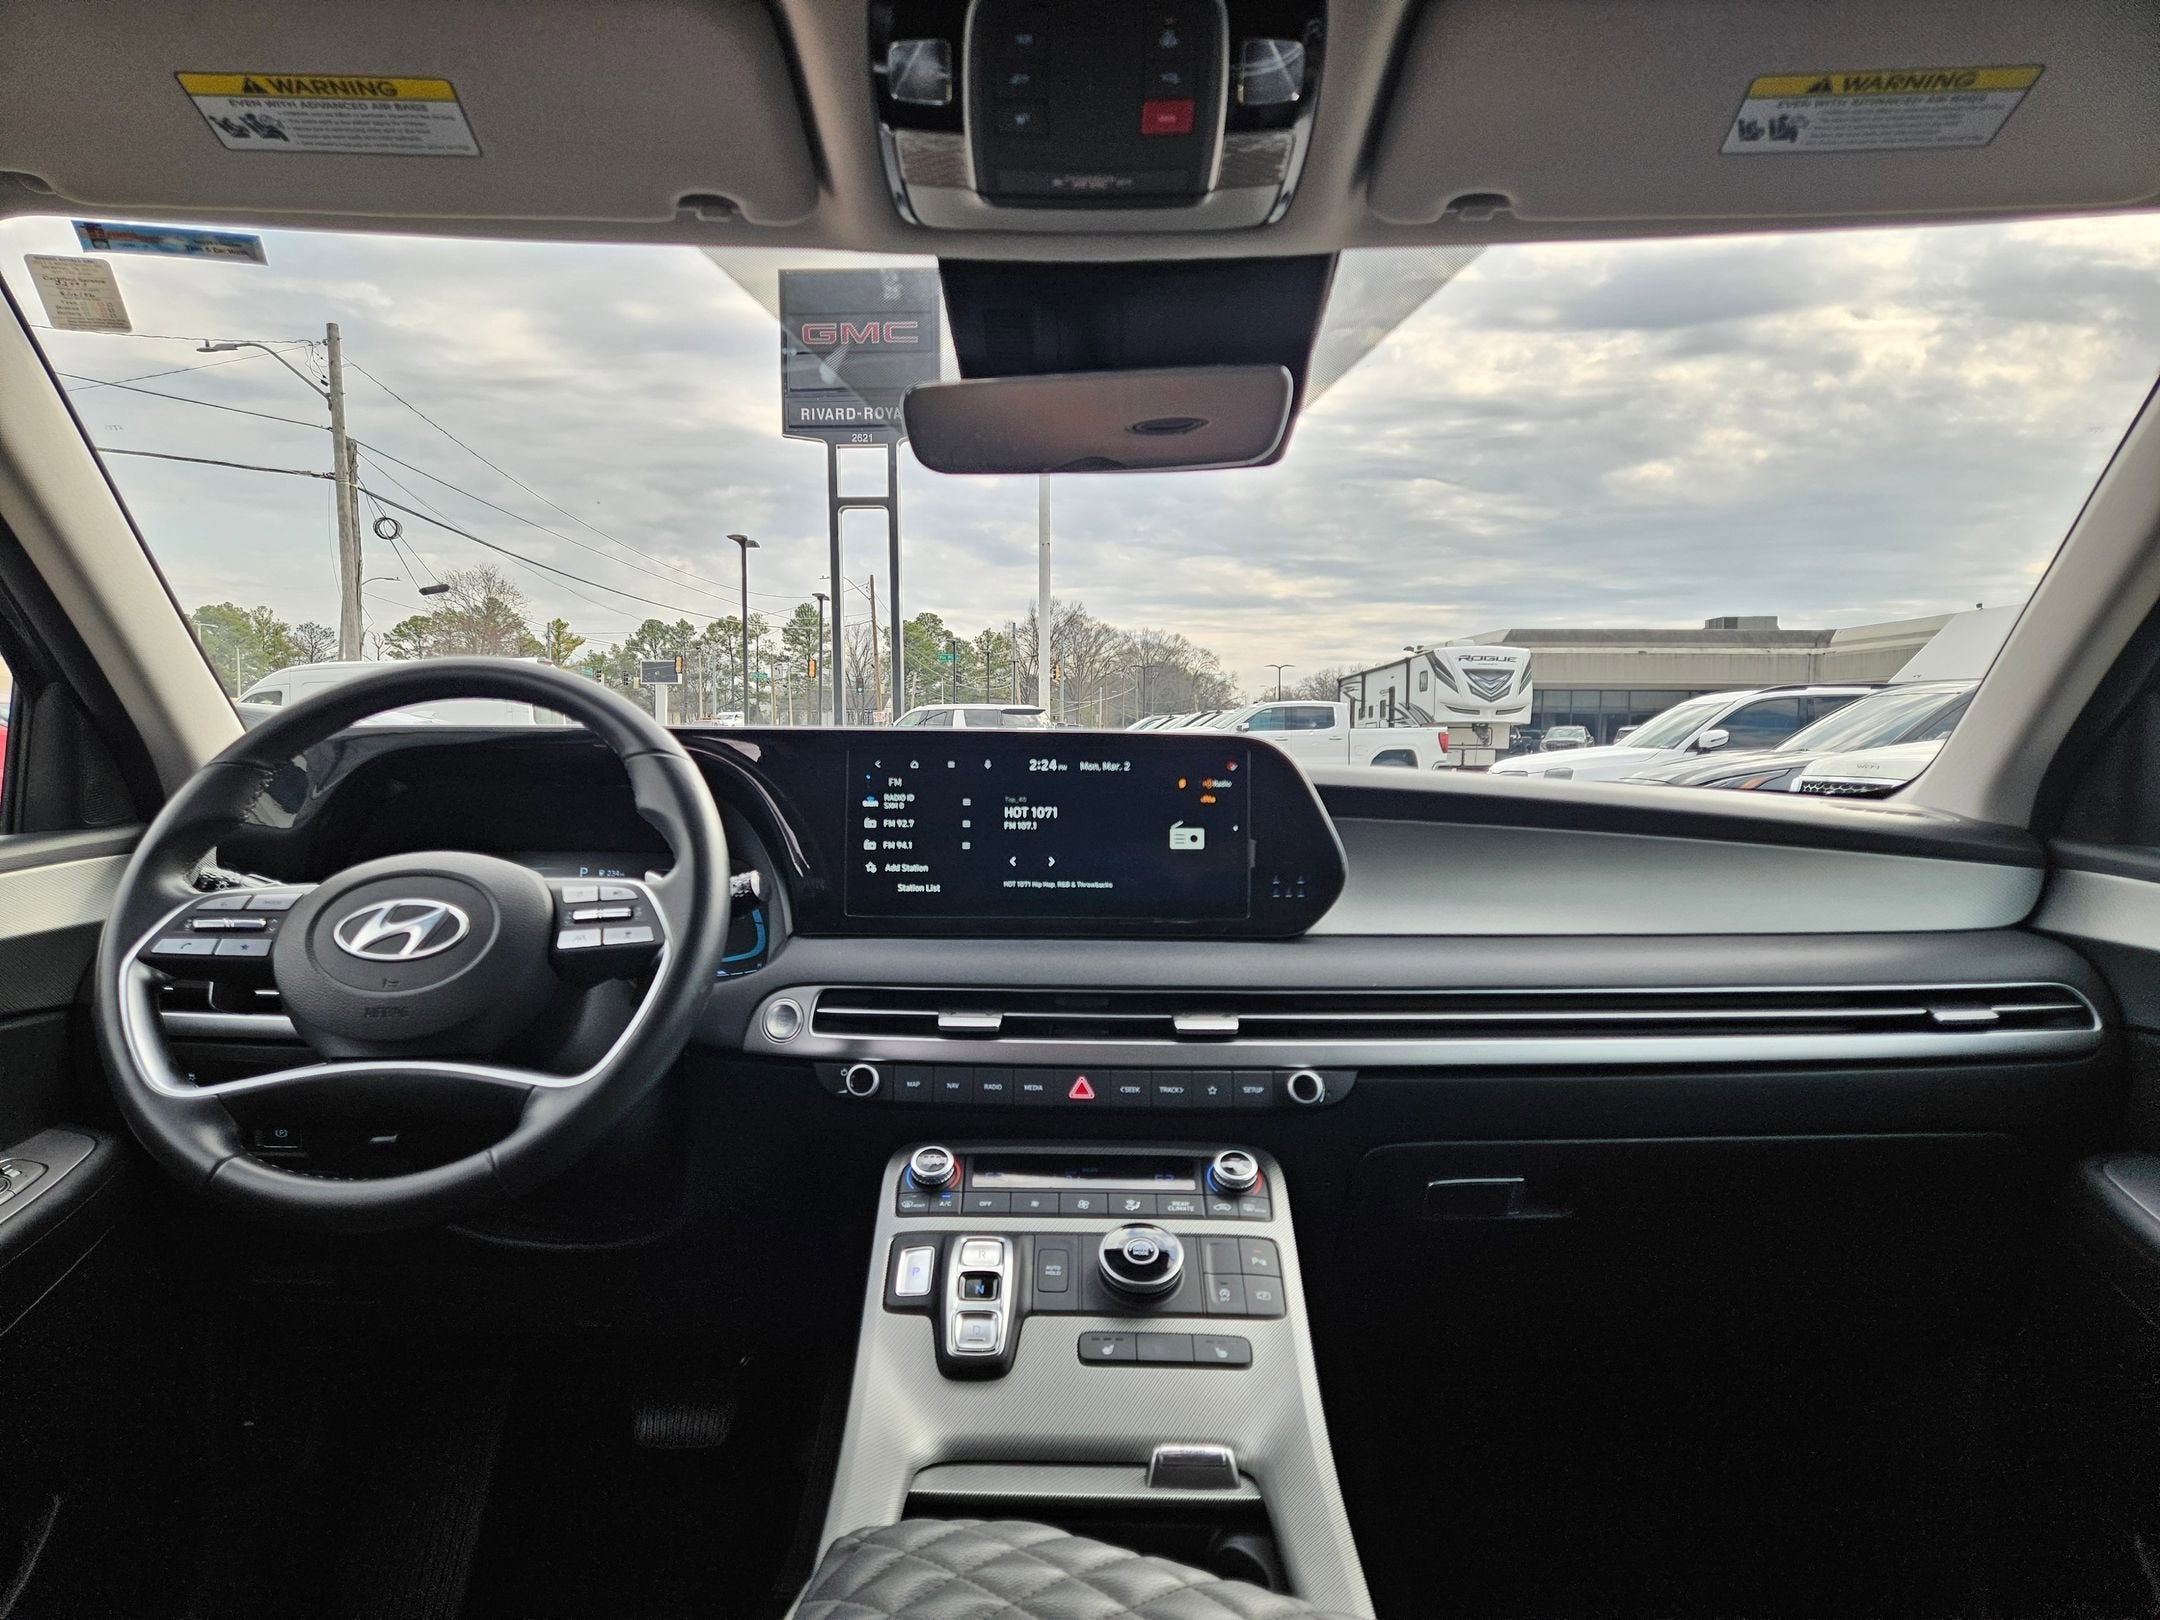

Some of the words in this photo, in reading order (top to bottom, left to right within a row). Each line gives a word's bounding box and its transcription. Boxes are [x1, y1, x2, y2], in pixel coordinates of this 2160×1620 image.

[1842, 71, 1979, 91] WARNING
[267, 78, 399, 98] WARNING
[802, 321, 918, 344] GMC
[1456, 654, 1518, 663] ROGUE
[1029, 758, 1057, 771] 2:24
[1123, 760, 1131, 771] 2
[888, 777, 902, 787] FM
[1004, 806, 1029, 819] HOT
[1031, 806, 1058, 819] 1071
[896, 819, 915, 828] 92.7
[579, 866, 589, 878] P
[884, 863, 901, 873] Add
[901, 863, 929, 873] Station
[897, 884, 925, 893] Station
[925, 884, 941, 893] List
[946, 1082, 960, 1090] NAV
[1242, 1086, 1265, 1094] SETUP
[978, 1250, 986, 1260] R
[911, 1266, 920, 1276] P
[975, 1284, 984, 1294] N
[972, 1324, 982, 1336] D
